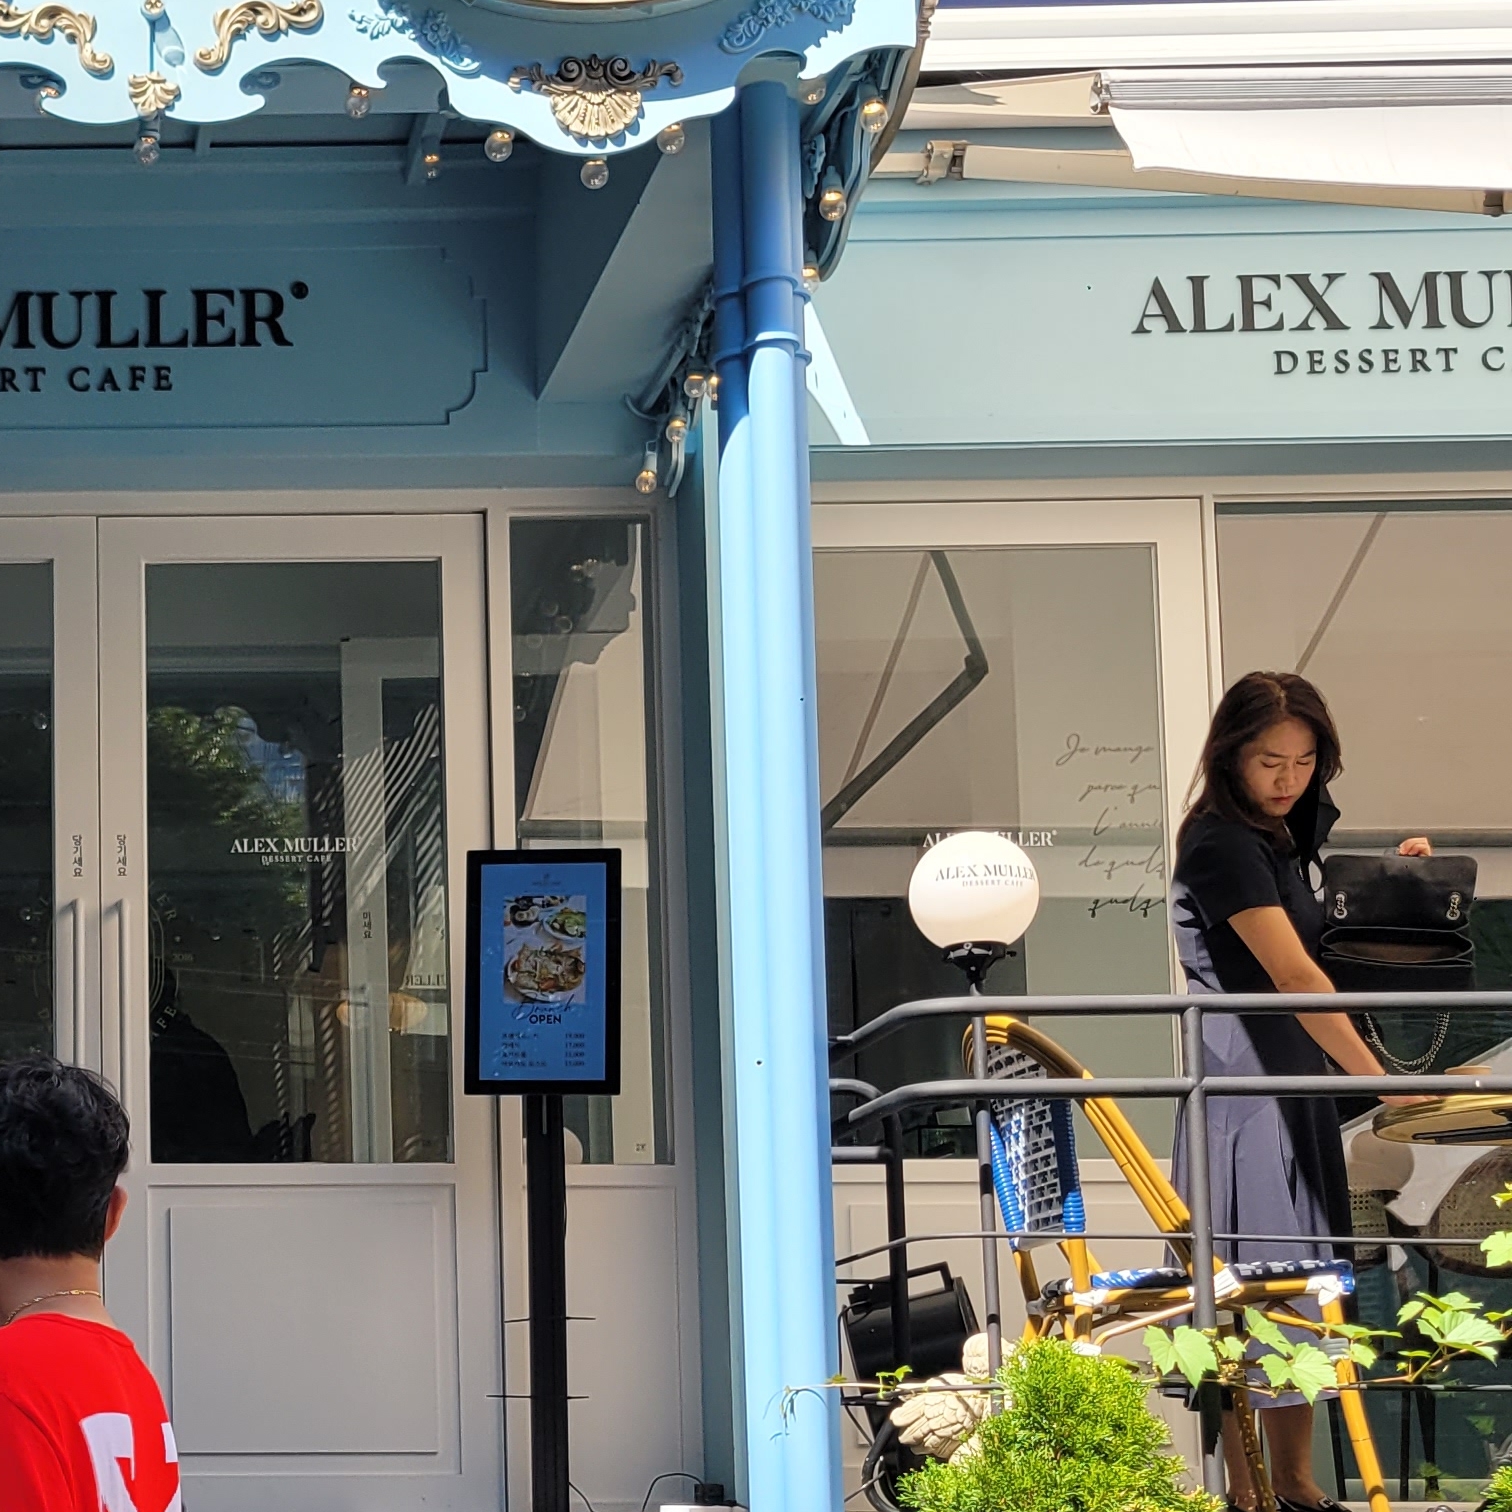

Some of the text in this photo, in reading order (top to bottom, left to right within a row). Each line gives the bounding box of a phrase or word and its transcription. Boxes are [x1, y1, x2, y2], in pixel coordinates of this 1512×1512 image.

[1131, 268, 1512, 335] ALEX MU
[1273, 345, 1512, 376] DESSERT C
[67, 365, 174, 392] CAFE
[72, 834, 83, 878] 당기세요
[116, 834, 128, 877] 당기세요
[230, 837, 359, 854] ALEX MULLER
[261, 854, 333, 864] DESSERT CAFE
[935, 864, 1036, 882] ALEX MULLER
[962, 879, 1001, 888] DESSERT
[528, 1014, 562, 1025] OPEN
